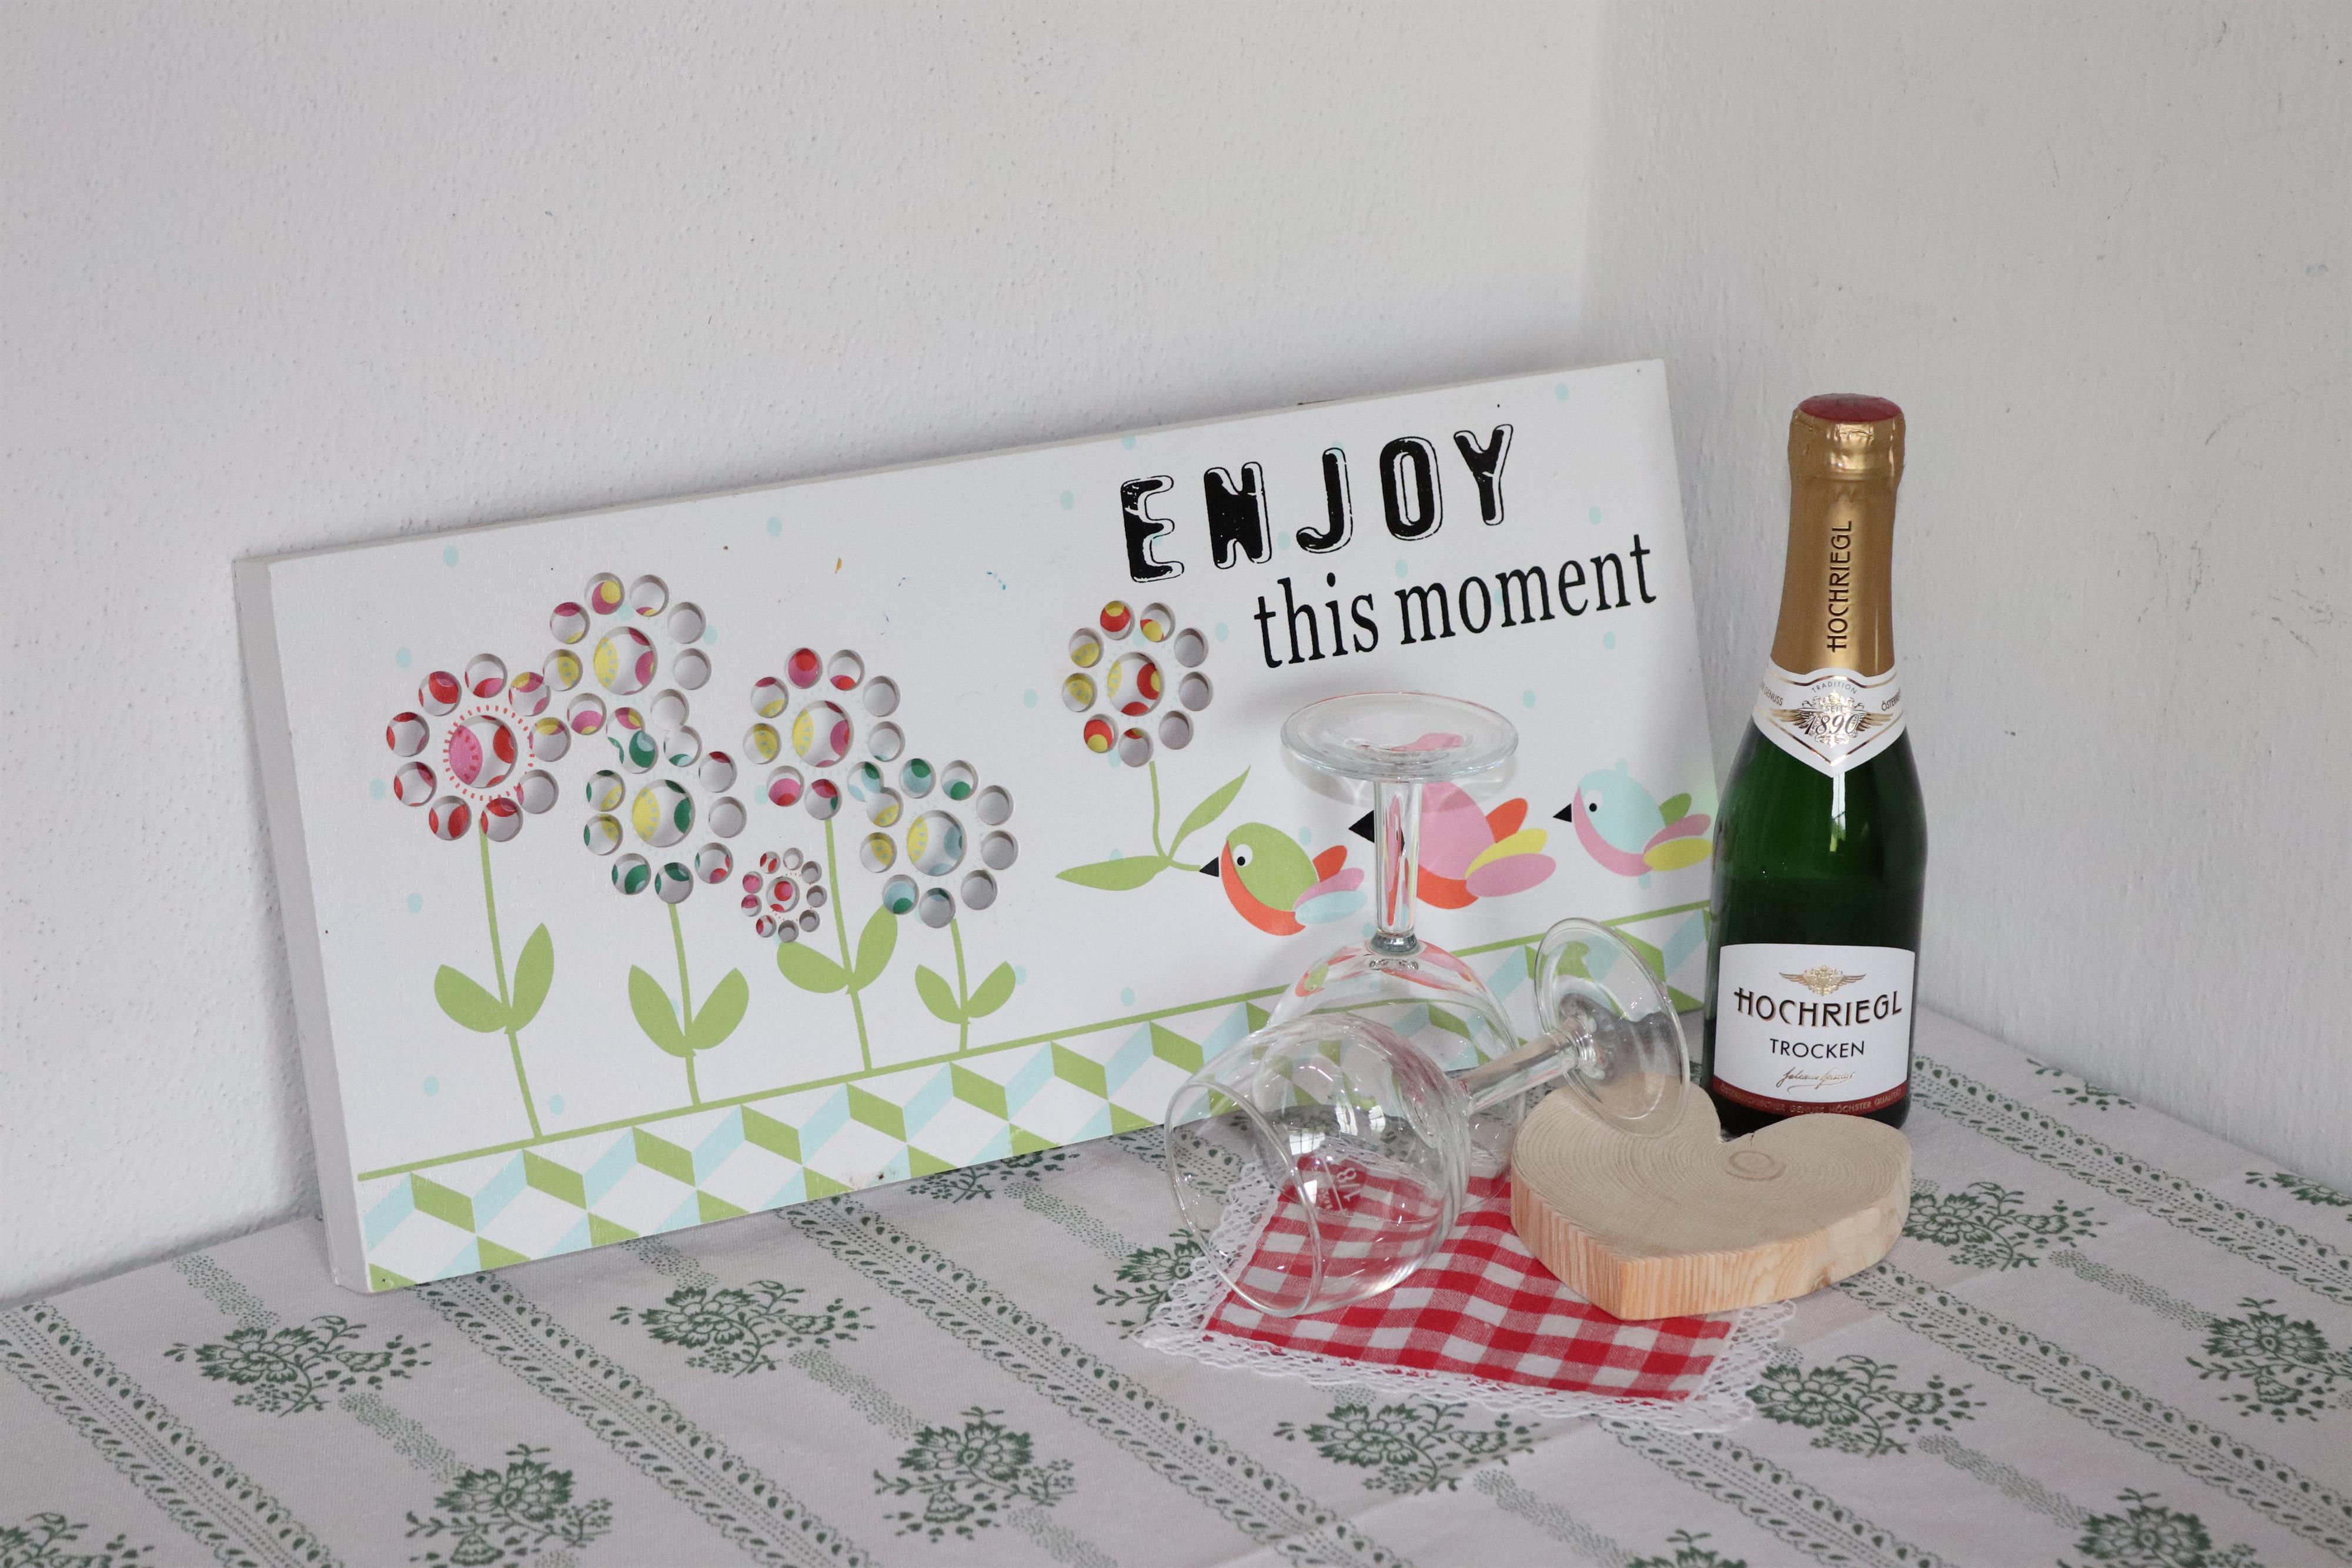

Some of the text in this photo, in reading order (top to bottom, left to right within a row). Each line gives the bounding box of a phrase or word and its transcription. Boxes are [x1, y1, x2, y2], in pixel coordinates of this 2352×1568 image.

[1120, 424, 1514, 583] ENJOY
[1254, 533, 1656, 668] this moment
[1827, 520, 1852, 653] HOCHRIEGL
[1811, 681, 1857, 694] TRADITION
[1804, 714, 1859, 734] 1890
[1734, 987, 1903, 1027] HOCHRIEGL
[1770, 1038, 1865, 1058] TROCKEN
[1829, 1101, 1872, 1114] HÖCHSTER
[1874, 1088, 1902, 1106] QUALITÄT
